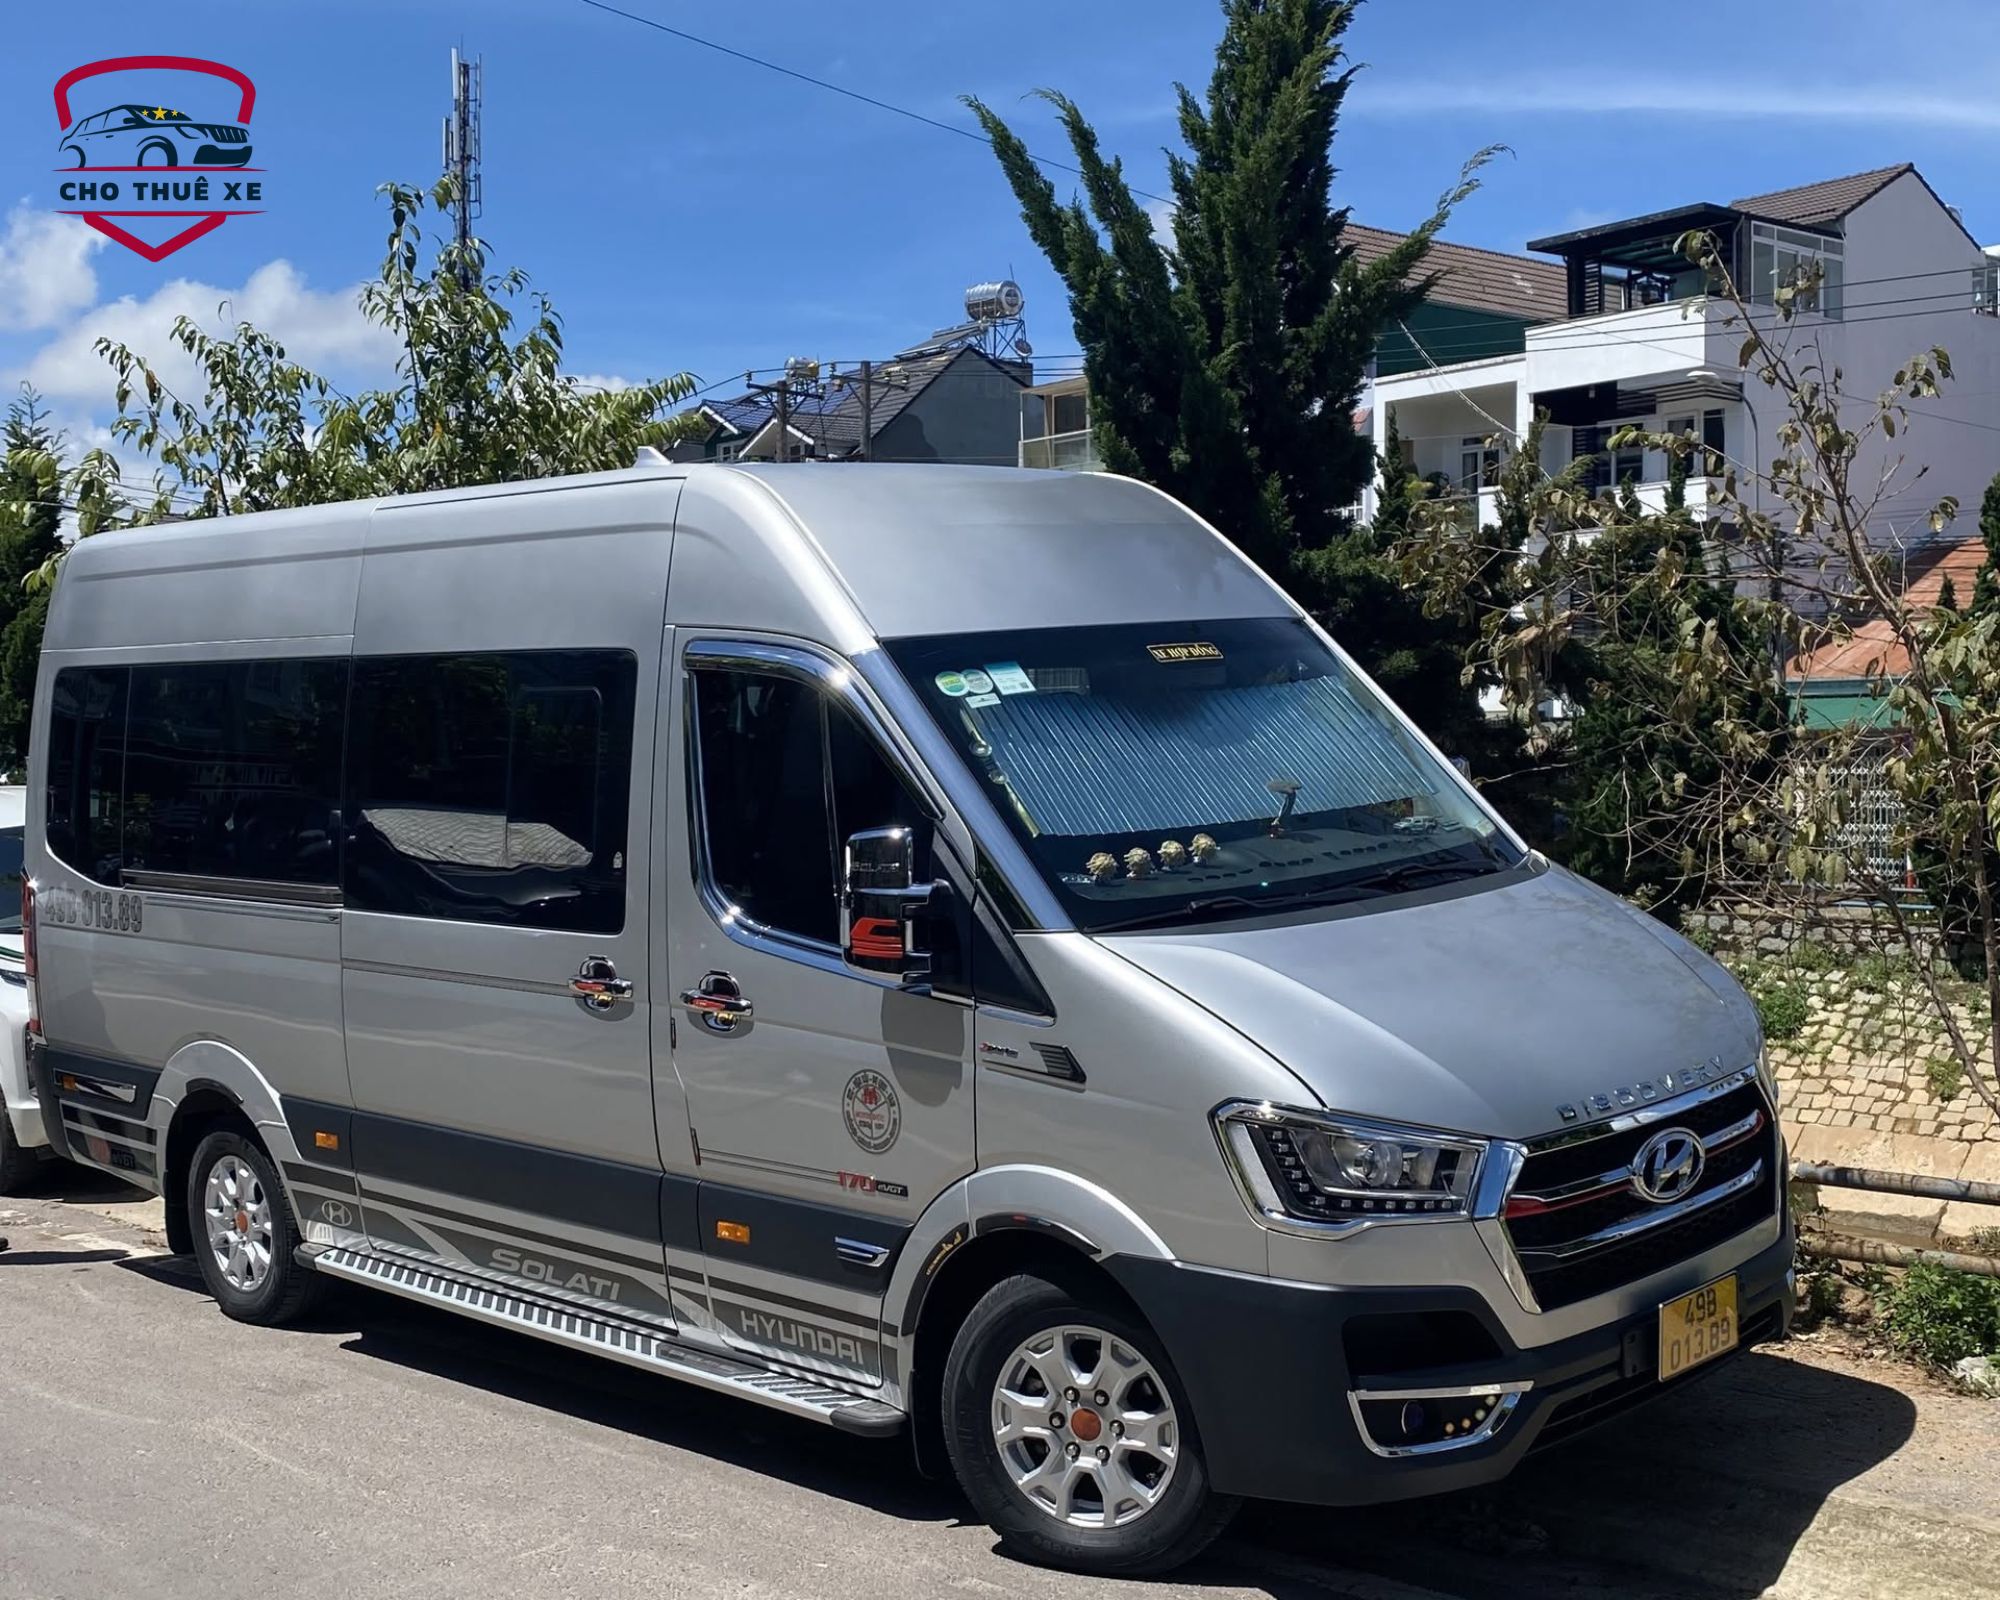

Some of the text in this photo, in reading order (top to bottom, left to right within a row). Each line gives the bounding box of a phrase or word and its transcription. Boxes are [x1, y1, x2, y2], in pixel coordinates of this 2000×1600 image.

[839, 1168, 876, 1192] 170
[488, 1248, 621, 1301] SOLATI
[1685, 1288, 1717, 1326] 49B
[740, 1310, 864, 1365] HYUNDAI
[1671, 1317, 1731, 1370] 013.89
